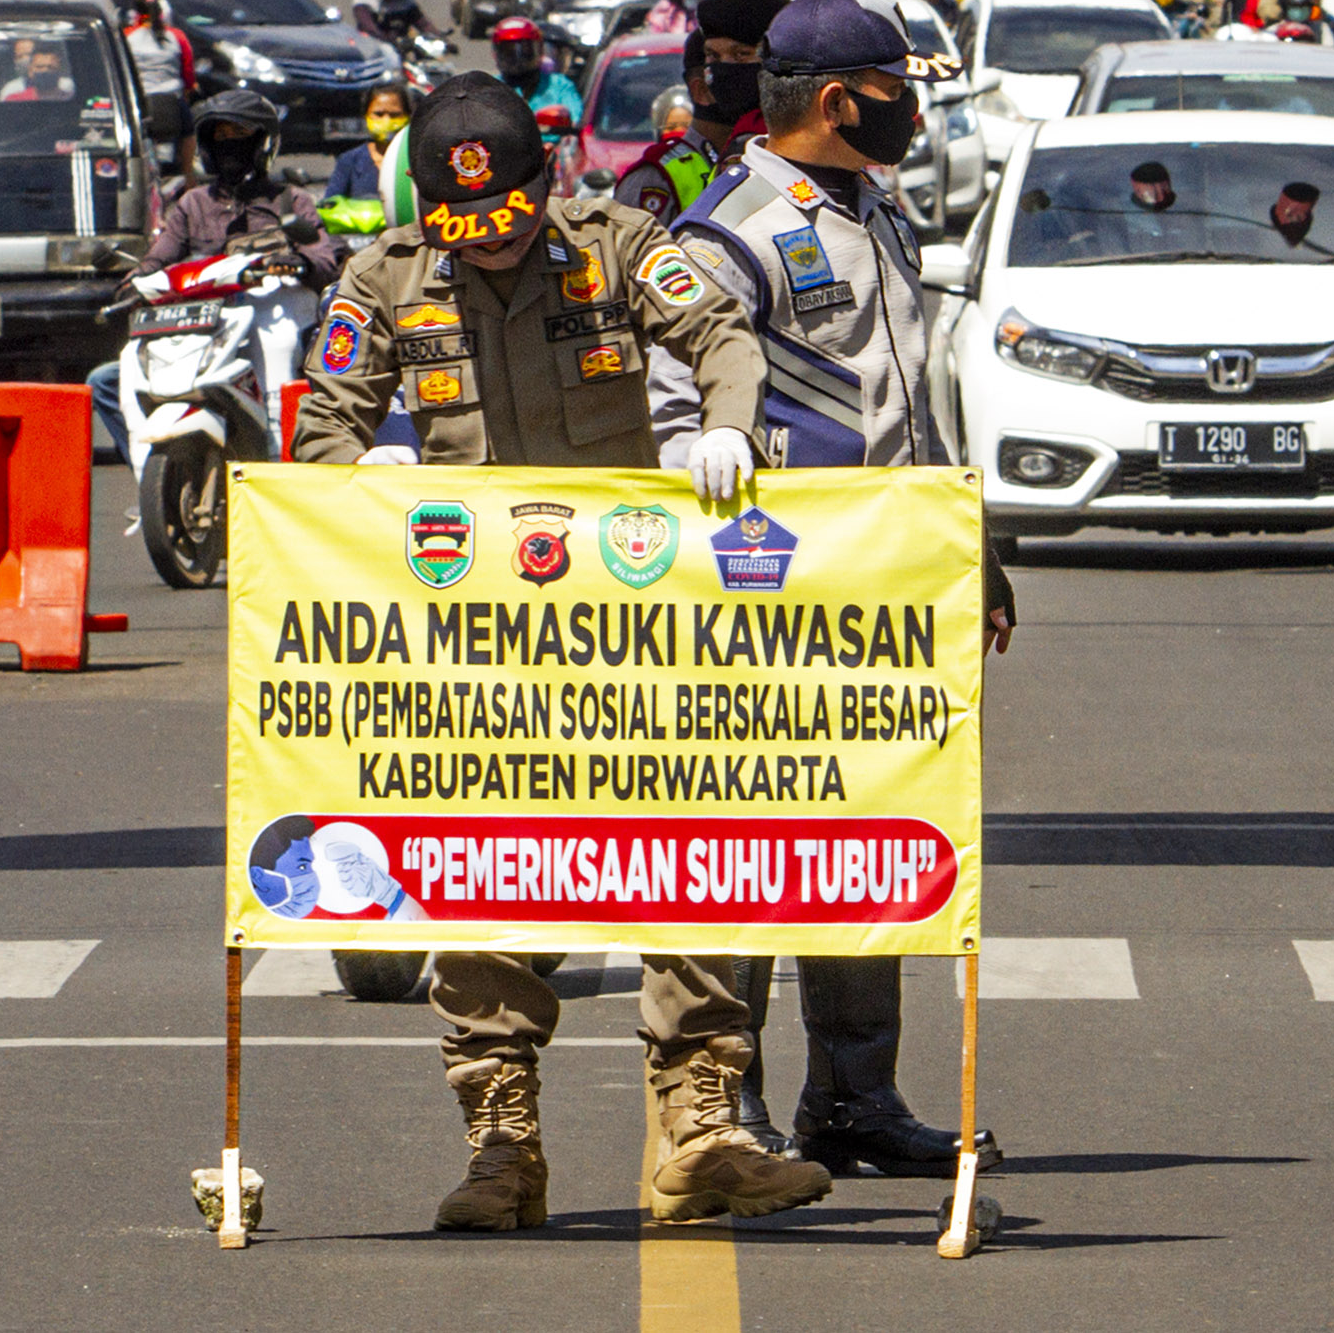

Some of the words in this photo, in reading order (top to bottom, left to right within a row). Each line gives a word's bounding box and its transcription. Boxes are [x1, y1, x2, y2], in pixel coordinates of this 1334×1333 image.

[424, 202, 489, 243] POL
[550, 315, 595, 338] POL
[603, 306, 626, 327] PP
[400, 339, 448, 360] ABDUL
[1165, 426, 1177, 453] T
[1196, 426, 1247, 453] 1290
[1273, 426, 1300, 453] BG
[513, 506, 537, 517] JAWA
[540, 504, 573, 517] BARAT
[727, 572, 779, 580] COVID-19
[274, 601, 411, 664] ANDA
[427, 602, 676, 667] MEMASUKI
[694, 604, 935, 668] KAWASAN
[259, 680, 332, 738] PSBB
[341, 680, 551, 748] (PEMBATASAN
[559, 682, 666, 741] SOSIAL
[675, 683, 832, 741] BERSKALA
[840, 683, 950, 750] BESAR)
[359, 752, 576, 800] KABUPATEN
[588, 754, 847, 802] PURWAKARTA
[685, 838, 785, 904] SUHU
